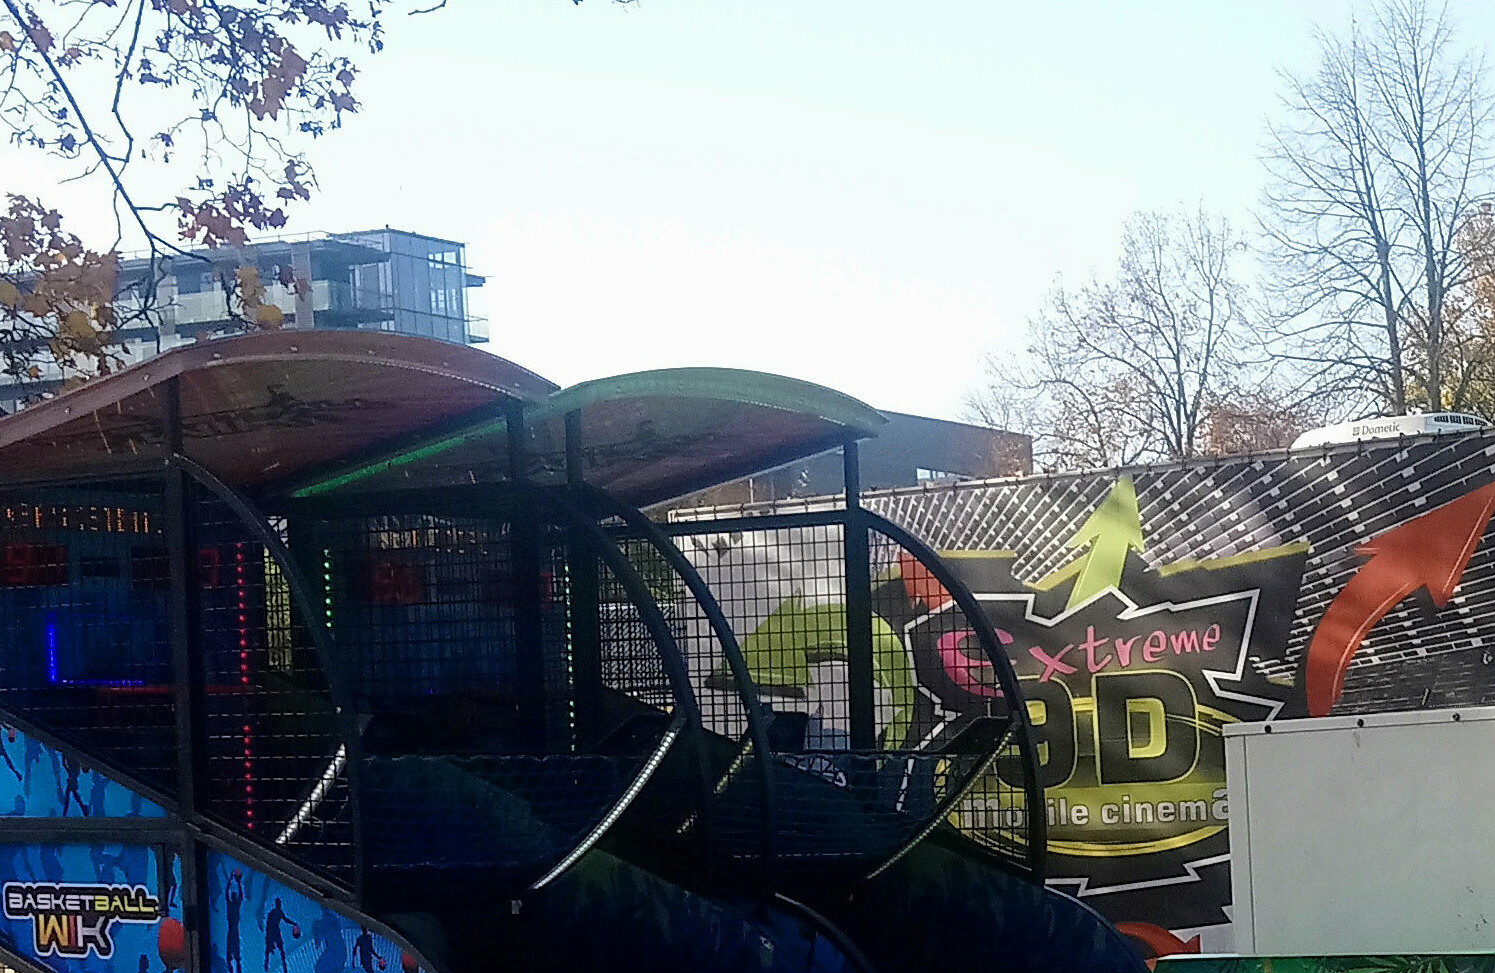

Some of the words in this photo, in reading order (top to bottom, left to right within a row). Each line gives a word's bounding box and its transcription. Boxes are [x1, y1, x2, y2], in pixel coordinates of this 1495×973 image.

[1362, 422, 1400, 435] Dometic
[964, 798, 1089, 828] moile
[8, 893, 159, 912] BASKETBALL
[39, 914, 107, 948] WIK
